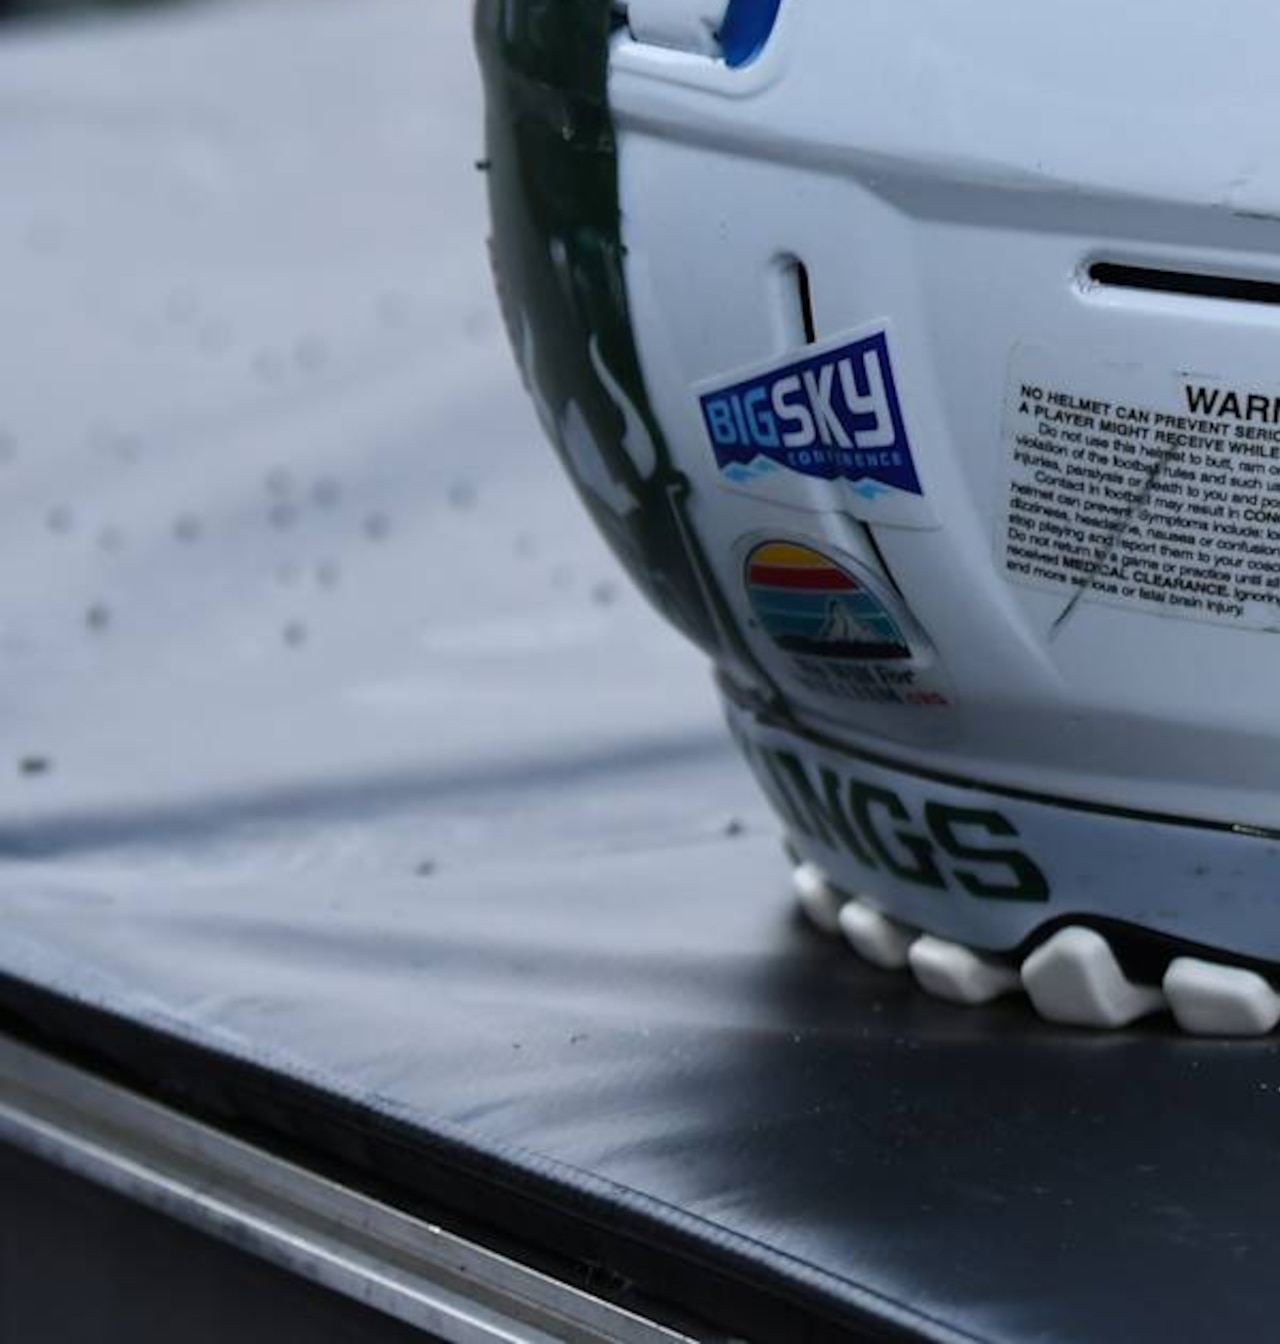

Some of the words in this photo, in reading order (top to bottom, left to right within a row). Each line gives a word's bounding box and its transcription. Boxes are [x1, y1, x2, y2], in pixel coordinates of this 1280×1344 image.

[1019, 402, 1028, 414] A
[1035, 405, 1094, 428] PLAYER
[1100, 419, 1149, 439] MIGHT
[1155, 431, 1224, 452] RECEIVE
[1229, 442, 1280, 458] WHILE
[1021, 384, 1042, 400] NO
[1048, 391, 1112, 415] HELMET
[1116, 406, 1149, 423] CAN
[1155, 412, 1230, 435] PREVENT
[1016, 435, 1067, 454] violation
[1072, 448, 1085, 459] of
[1088, 450, 1109, 466] the
[1164, 466, 1195, 480] rules
[1200, 472, 1226, 485] and
[1229, 476, 1262, 490] such
[1039, 422, 1057, 437] Do
[1061, 430, 1082, 442] not
[1086, 436, 1109, 449] use
[1113, 439, 1136, 454] this
[1190, 453, 1201, 465] to
[1239, 461, 1264, 474] ram
[1010, 482, 1054, 501] helmet
[1057, 494, 1081, 506] can
[1034, 470, 1084, 491] Contact
[1089, 484, 1100, 494] in
[1155, 497, 1183, 512] may
[1188, 503, 1224, 517] result
[1228, 507, 1239, 518] in
[1066, 465, 1124, 484] paralysis
[1128, 476, 1142, 487] or
[1187, 486, 1199, 497] to
[1203, 489, 1227, 501] you
[1231, 493, 1257, 505] and
[1008, 514, 1035, 529] stop
[1039, 521, 1084, 542] playing
[1088, 533, 1114, 546] and
[1118, 538, 1156, 553] eport
[1160, 545, 1193, 560] them
[1197, 551, 1210, 562] to
[1214, 555, 1244, 568] your
[1075, 512, 1141, 537] headae,
[1147, 528, 1195, 545] nausea
[1199, 537, 1213, 546] or
[1007, 545, 1058, 565] received
[1062, 557, 1129, 580] MEDICAL
[1008, 527, 1026, 541] Do
[1029, 534, 1049, 547] not
[1053, 539, 1090, 556] return
[1121, 555, 1158, 570] game
[1163, 563, 1176, 573] or
[1179, 565, 1231, 582] practice
[1235, 573, 1262, 585] until
[1266, 577, 1280, 588] all
[1007, 560, 1030, 574] and
[1033, 566, 1066, 582] more
[1121, 586, 1135, 596] or
[1139, 588, 1166, 602] fatal
[1169, 593, 1202, 607] brain
